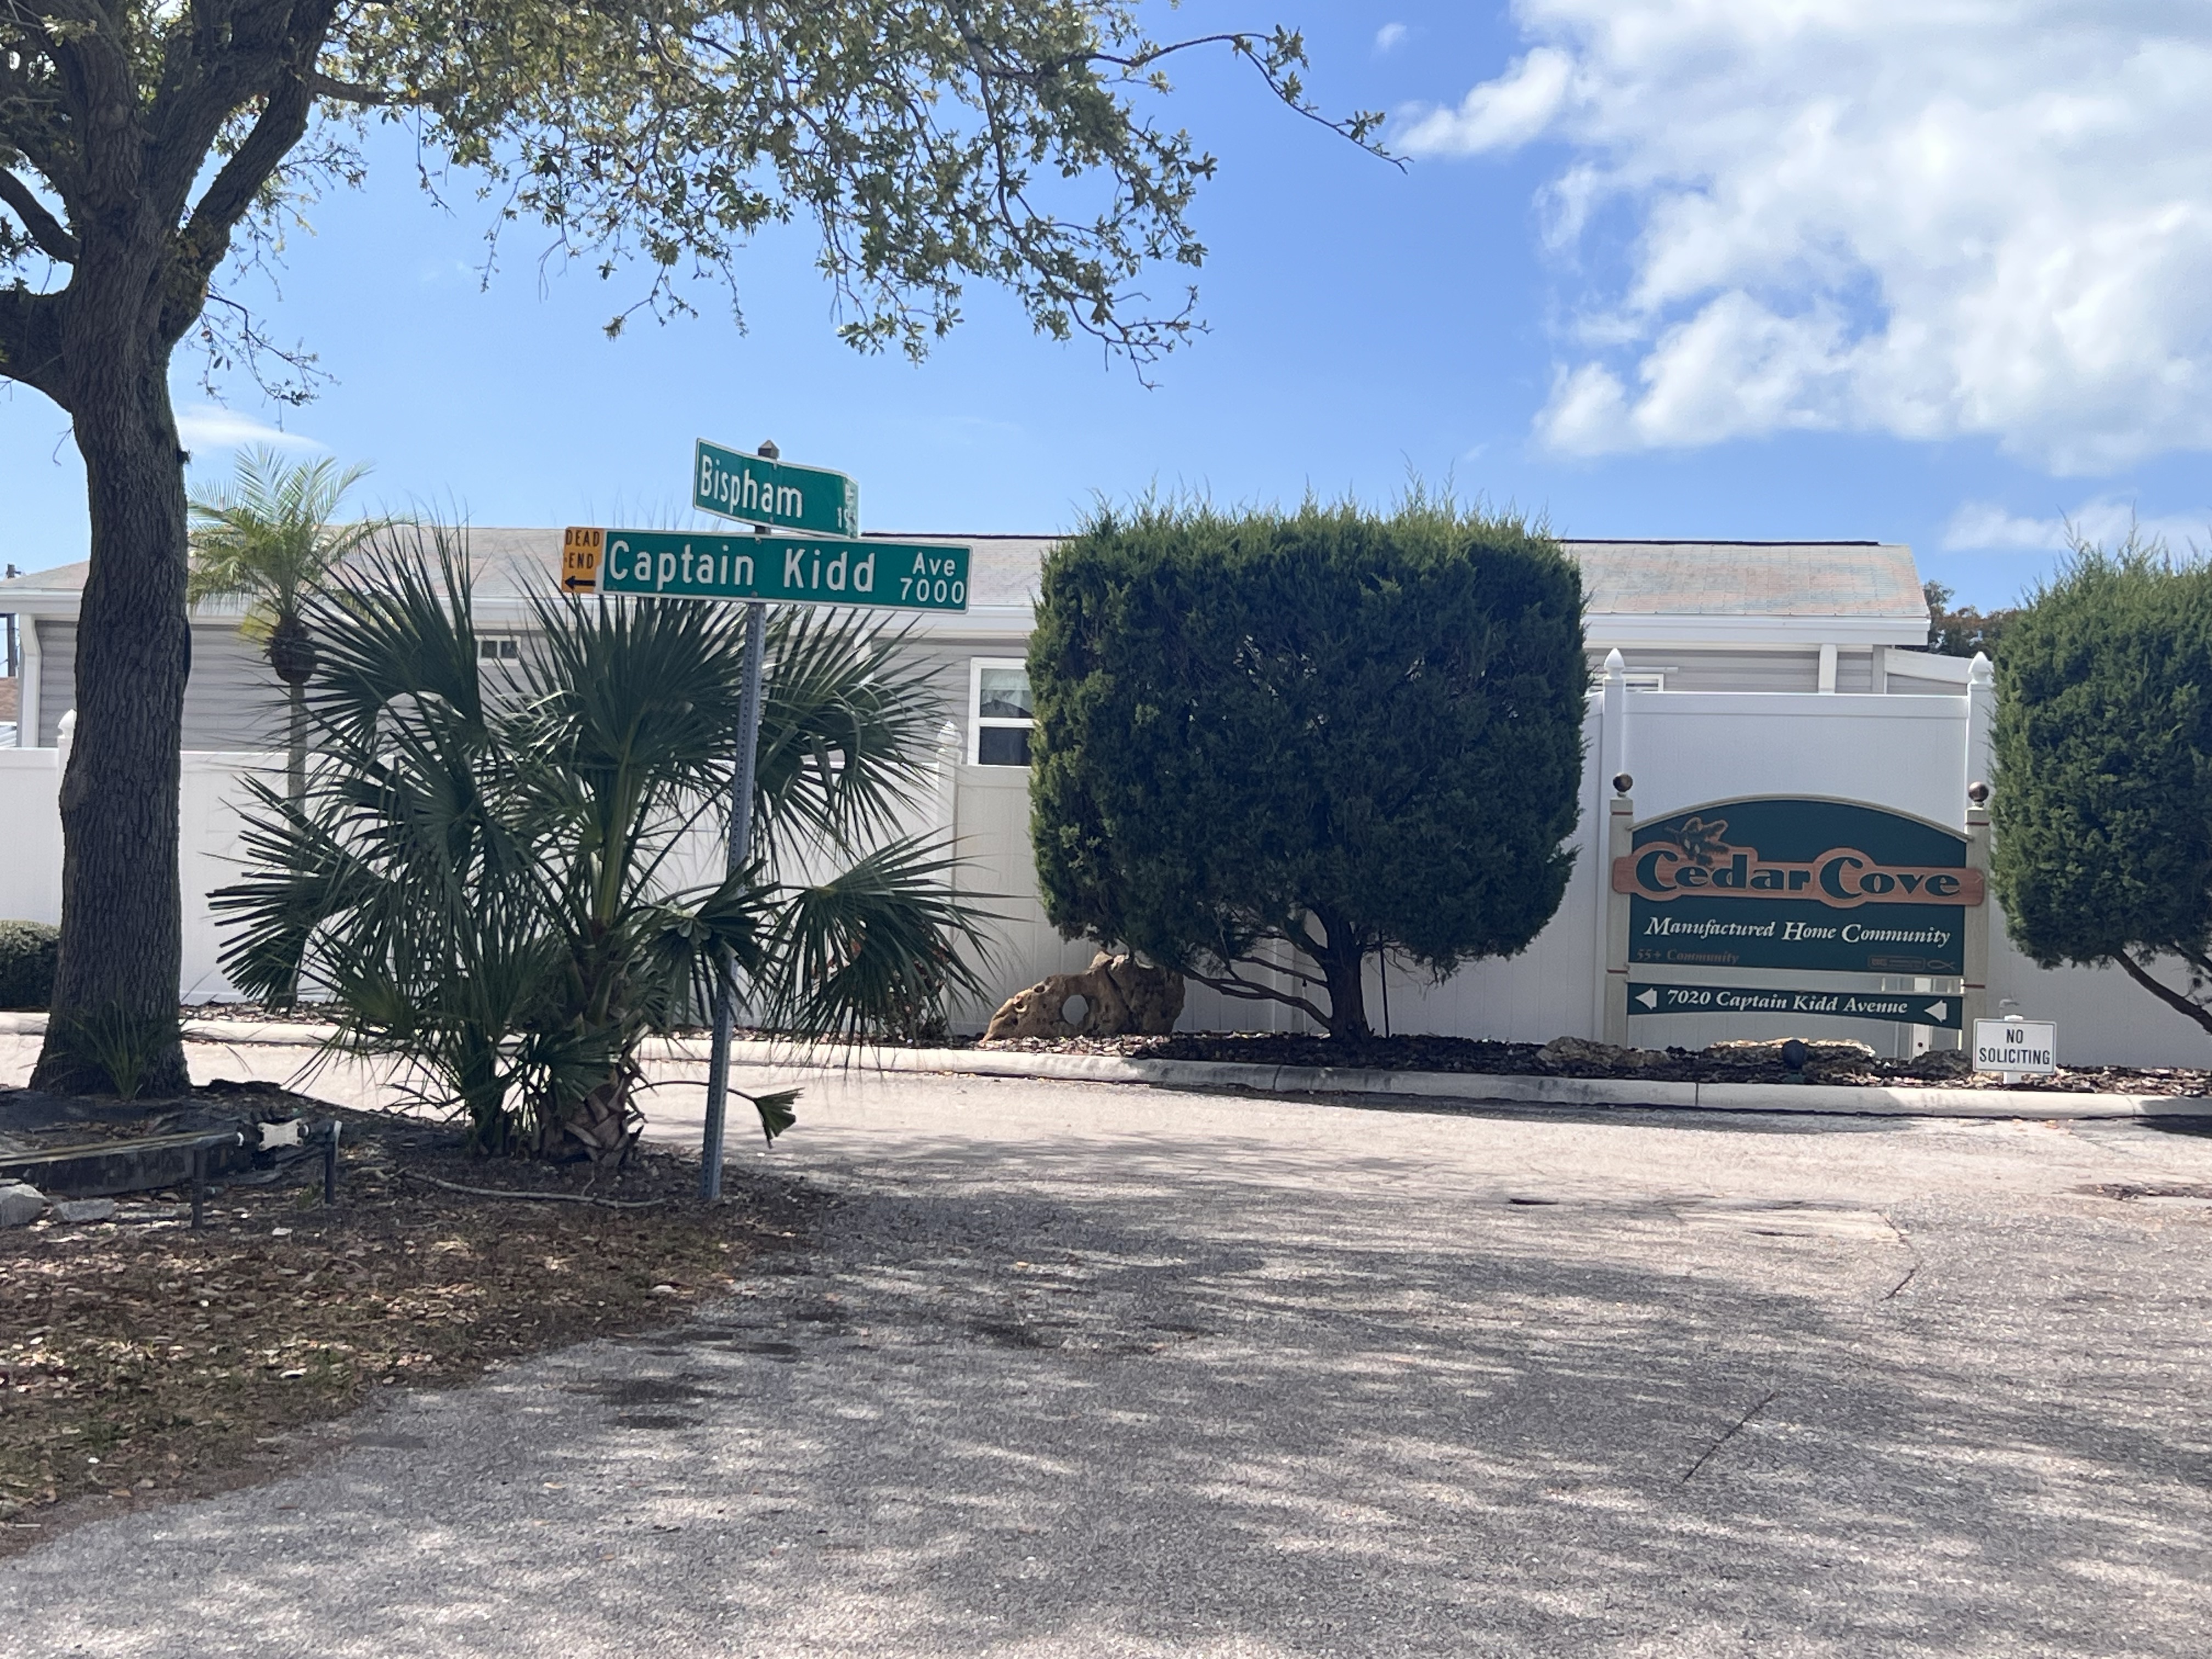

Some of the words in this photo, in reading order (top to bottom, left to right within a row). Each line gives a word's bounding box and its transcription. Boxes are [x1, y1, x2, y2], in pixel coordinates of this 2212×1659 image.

[699, 454, 803, 519] Bispham
[565, 529, 600, 547] DEAD
[569, 552, 594, 569] END
[608, 539, 754, 591] Captain
[783, 549, 875, 592] Kidd
[911, 551, 956, 577] Ave
[900, 578, 966, 605] 7000
[1635, 849, 1810, 893] Cedar
[1819, 856, 1961, 899] Cove
[1644, 916, 1776, 939] Manufactured
[1781, 921, 1837, 941] Home
[1841, 923, 1950, 949] Community
[1637, 948, 1662, 962] 55+
[1666, 949, 1740, 964] Community
[1667, 989, 1711, 1006] 7020
[1716, 991, 1787, 1011] Captain
[1792, 995, 1839, 1012] Kidd
[1843, 997, 1908, 1014] Avenue
[2006, 1029, 2024, 1044] NO
[1979, 1047, 2051, 1065] SOLICITING
